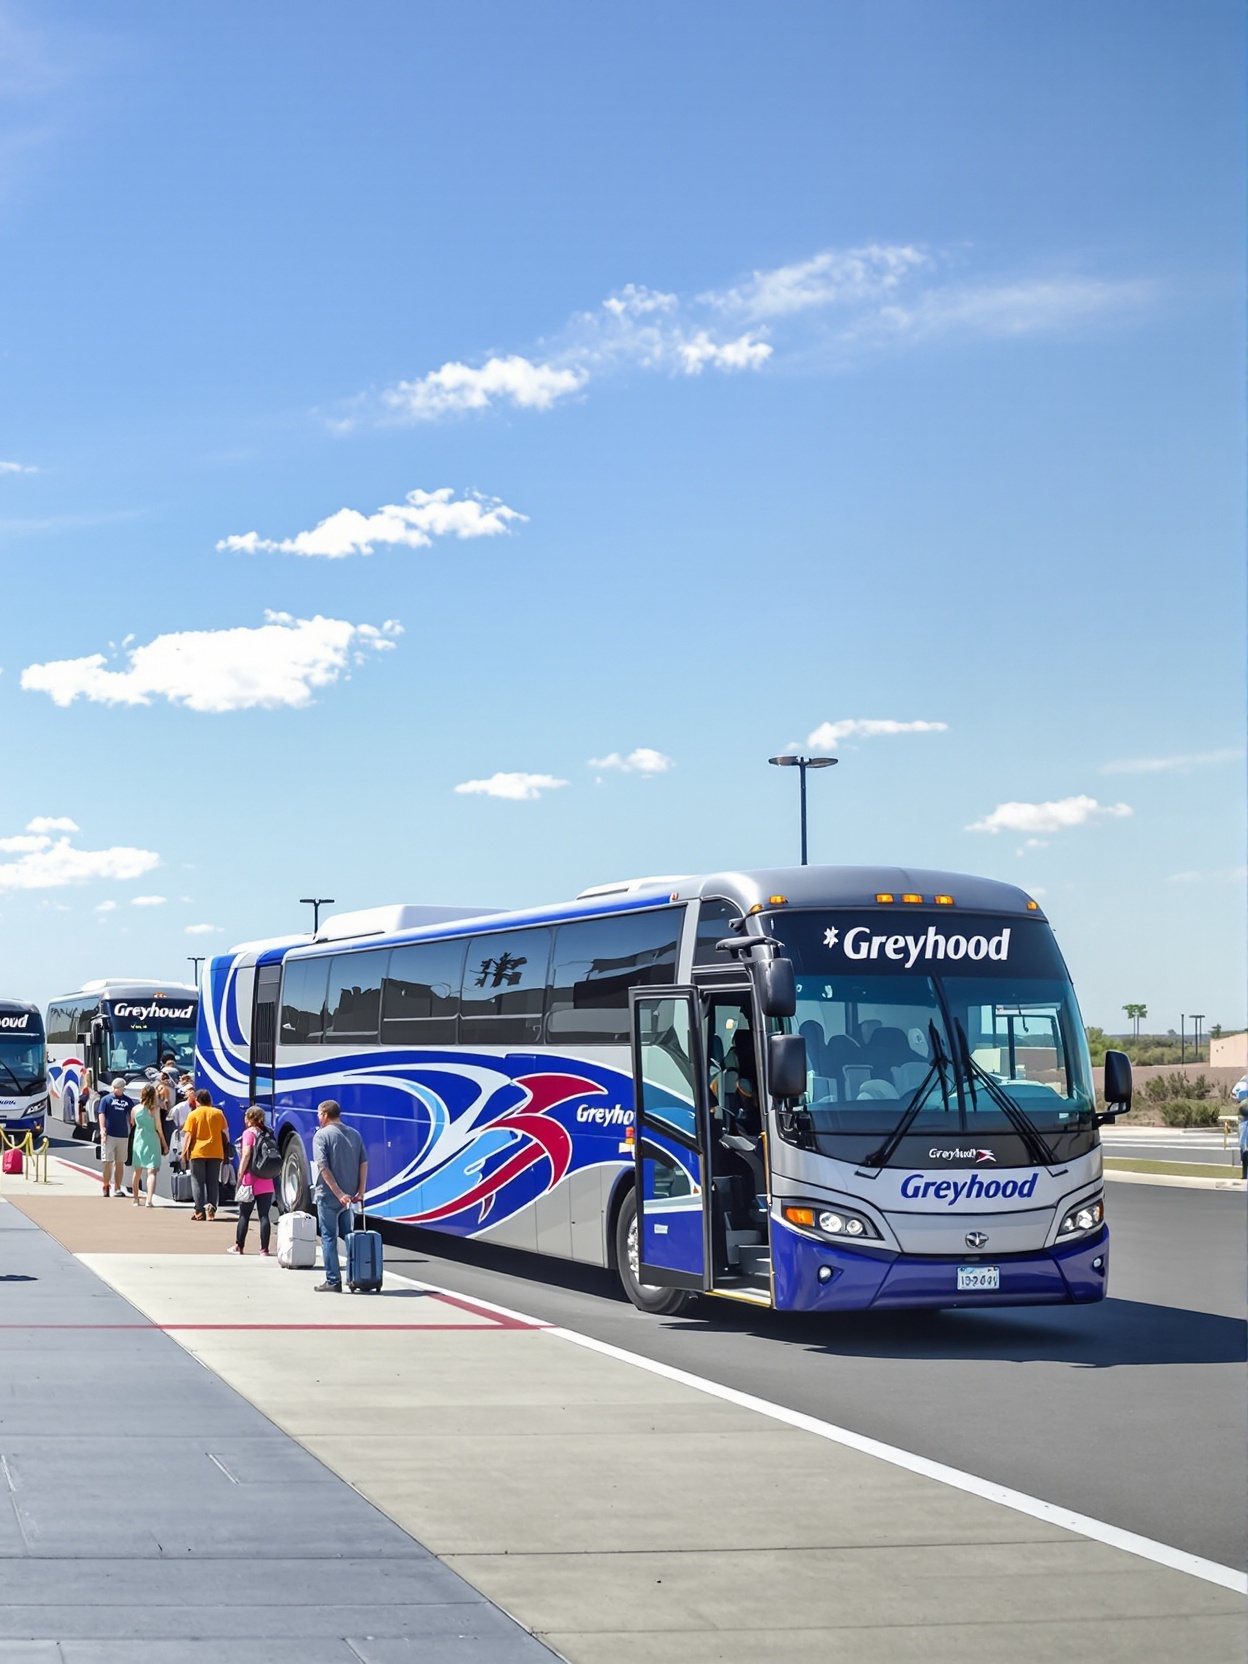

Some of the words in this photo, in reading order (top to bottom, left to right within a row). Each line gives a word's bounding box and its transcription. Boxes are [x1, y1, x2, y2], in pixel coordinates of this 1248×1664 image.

[843, 926, 1011, 969] Greyhood
[576, 1103, 635, 1127] Greyho
[900, 1172, 1040, 1206] Greyhood
